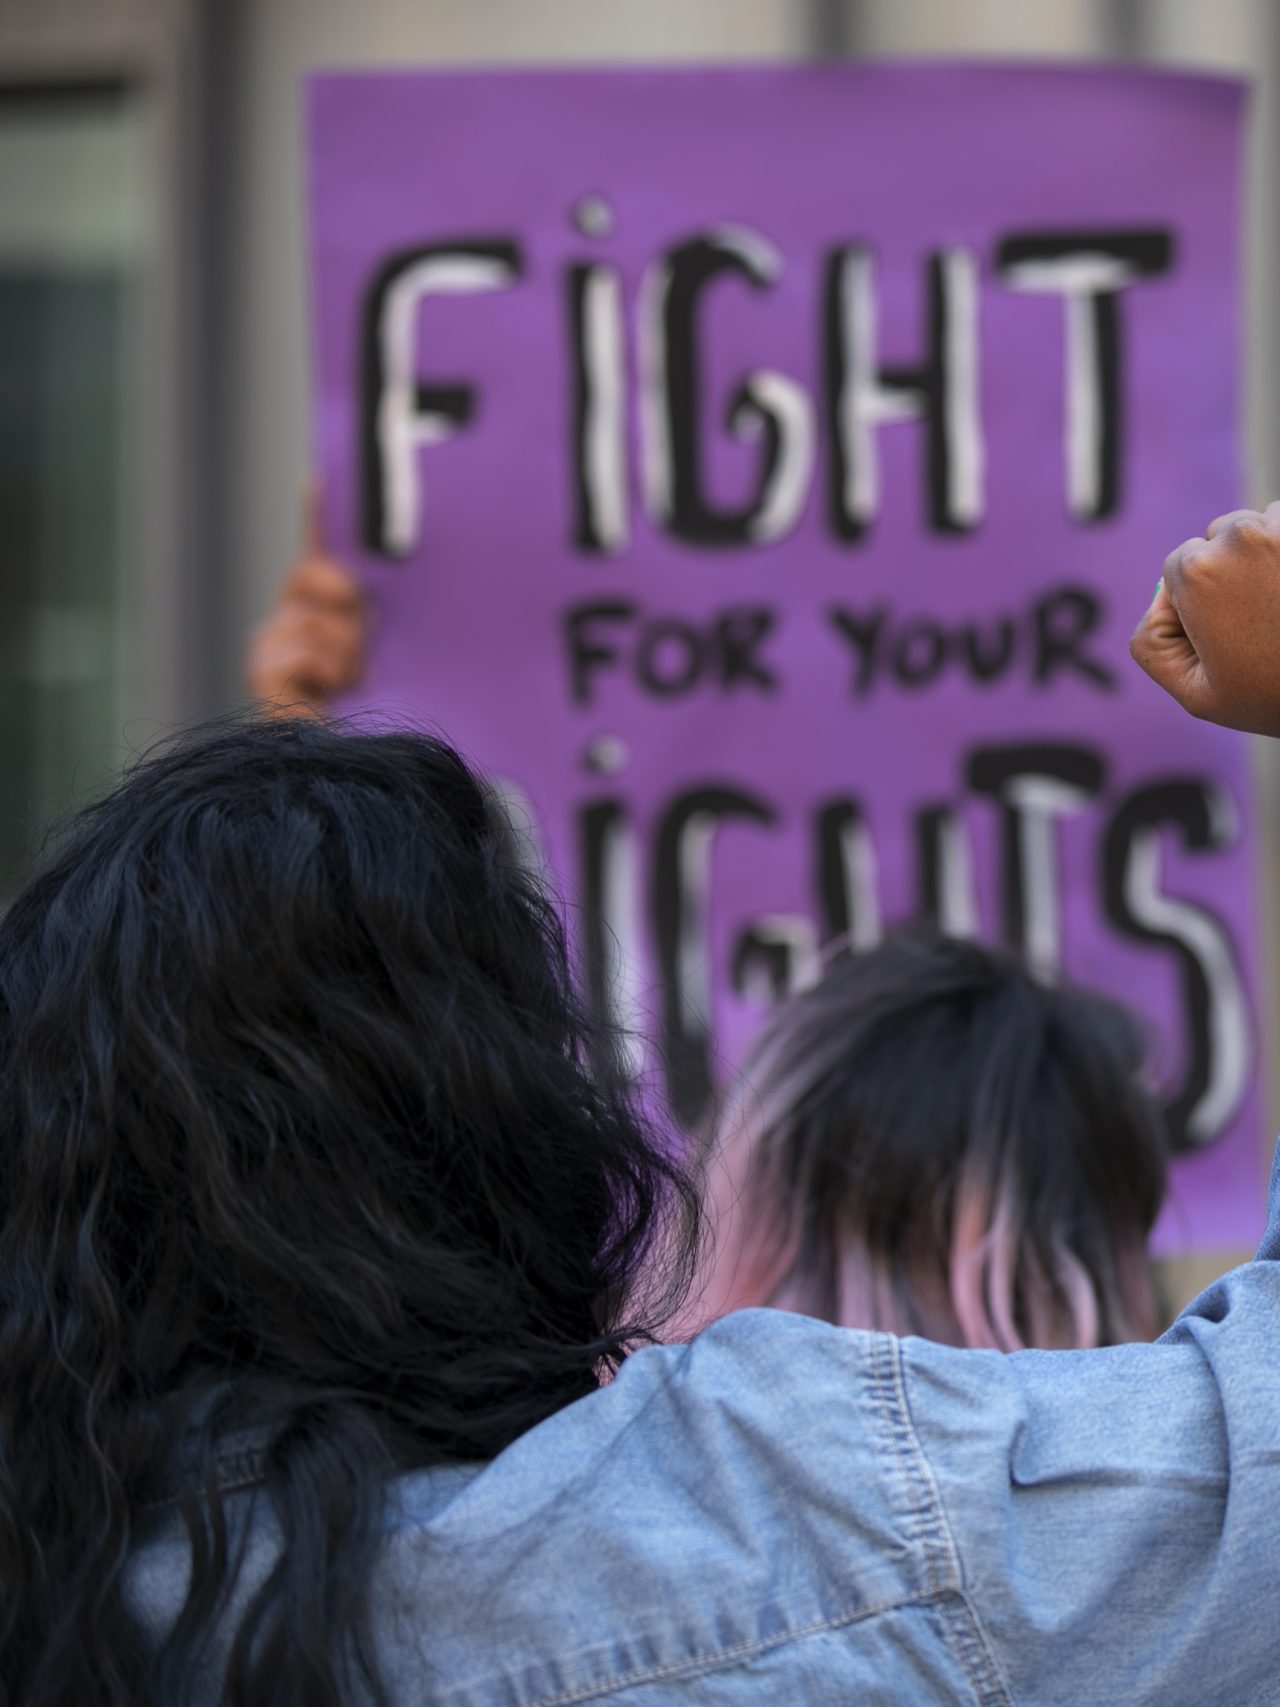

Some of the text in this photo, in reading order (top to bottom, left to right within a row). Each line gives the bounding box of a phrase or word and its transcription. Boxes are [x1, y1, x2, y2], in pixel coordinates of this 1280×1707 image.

[562, 586, 1120, 710] FOR YOUR
[488, 734, 1252, 1158] iGTS
